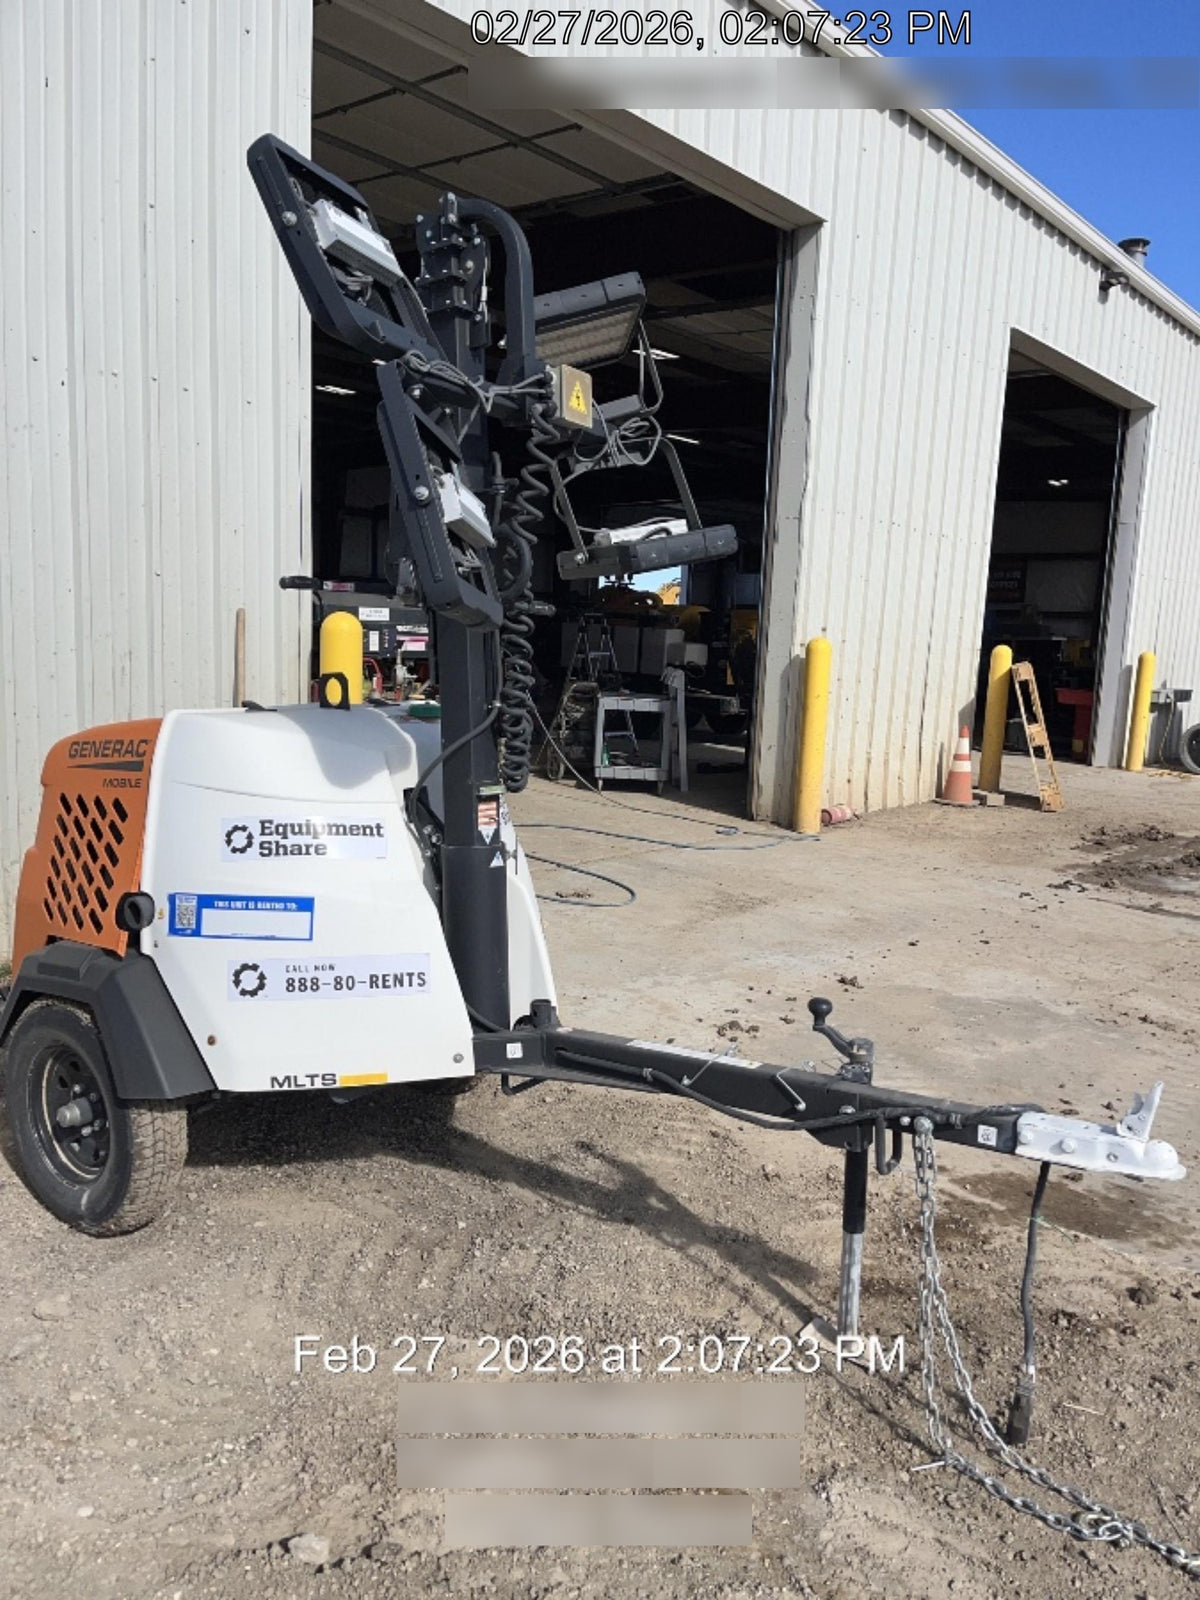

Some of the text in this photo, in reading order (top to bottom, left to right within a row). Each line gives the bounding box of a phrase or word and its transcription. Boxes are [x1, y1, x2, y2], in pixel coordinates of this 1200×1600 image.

[68, 739, 148, 759] GENERAC
[102, 778, 142, 788] MOBILE
[259, 819, 385, 839] Equipment
[259, 840, 328, 858] Share
[285, 963, 336, 973] CALL NOW
[285, 971, 427, 993] 888-80-RENTS
[270, 1073, 337, 1089] MLTS
